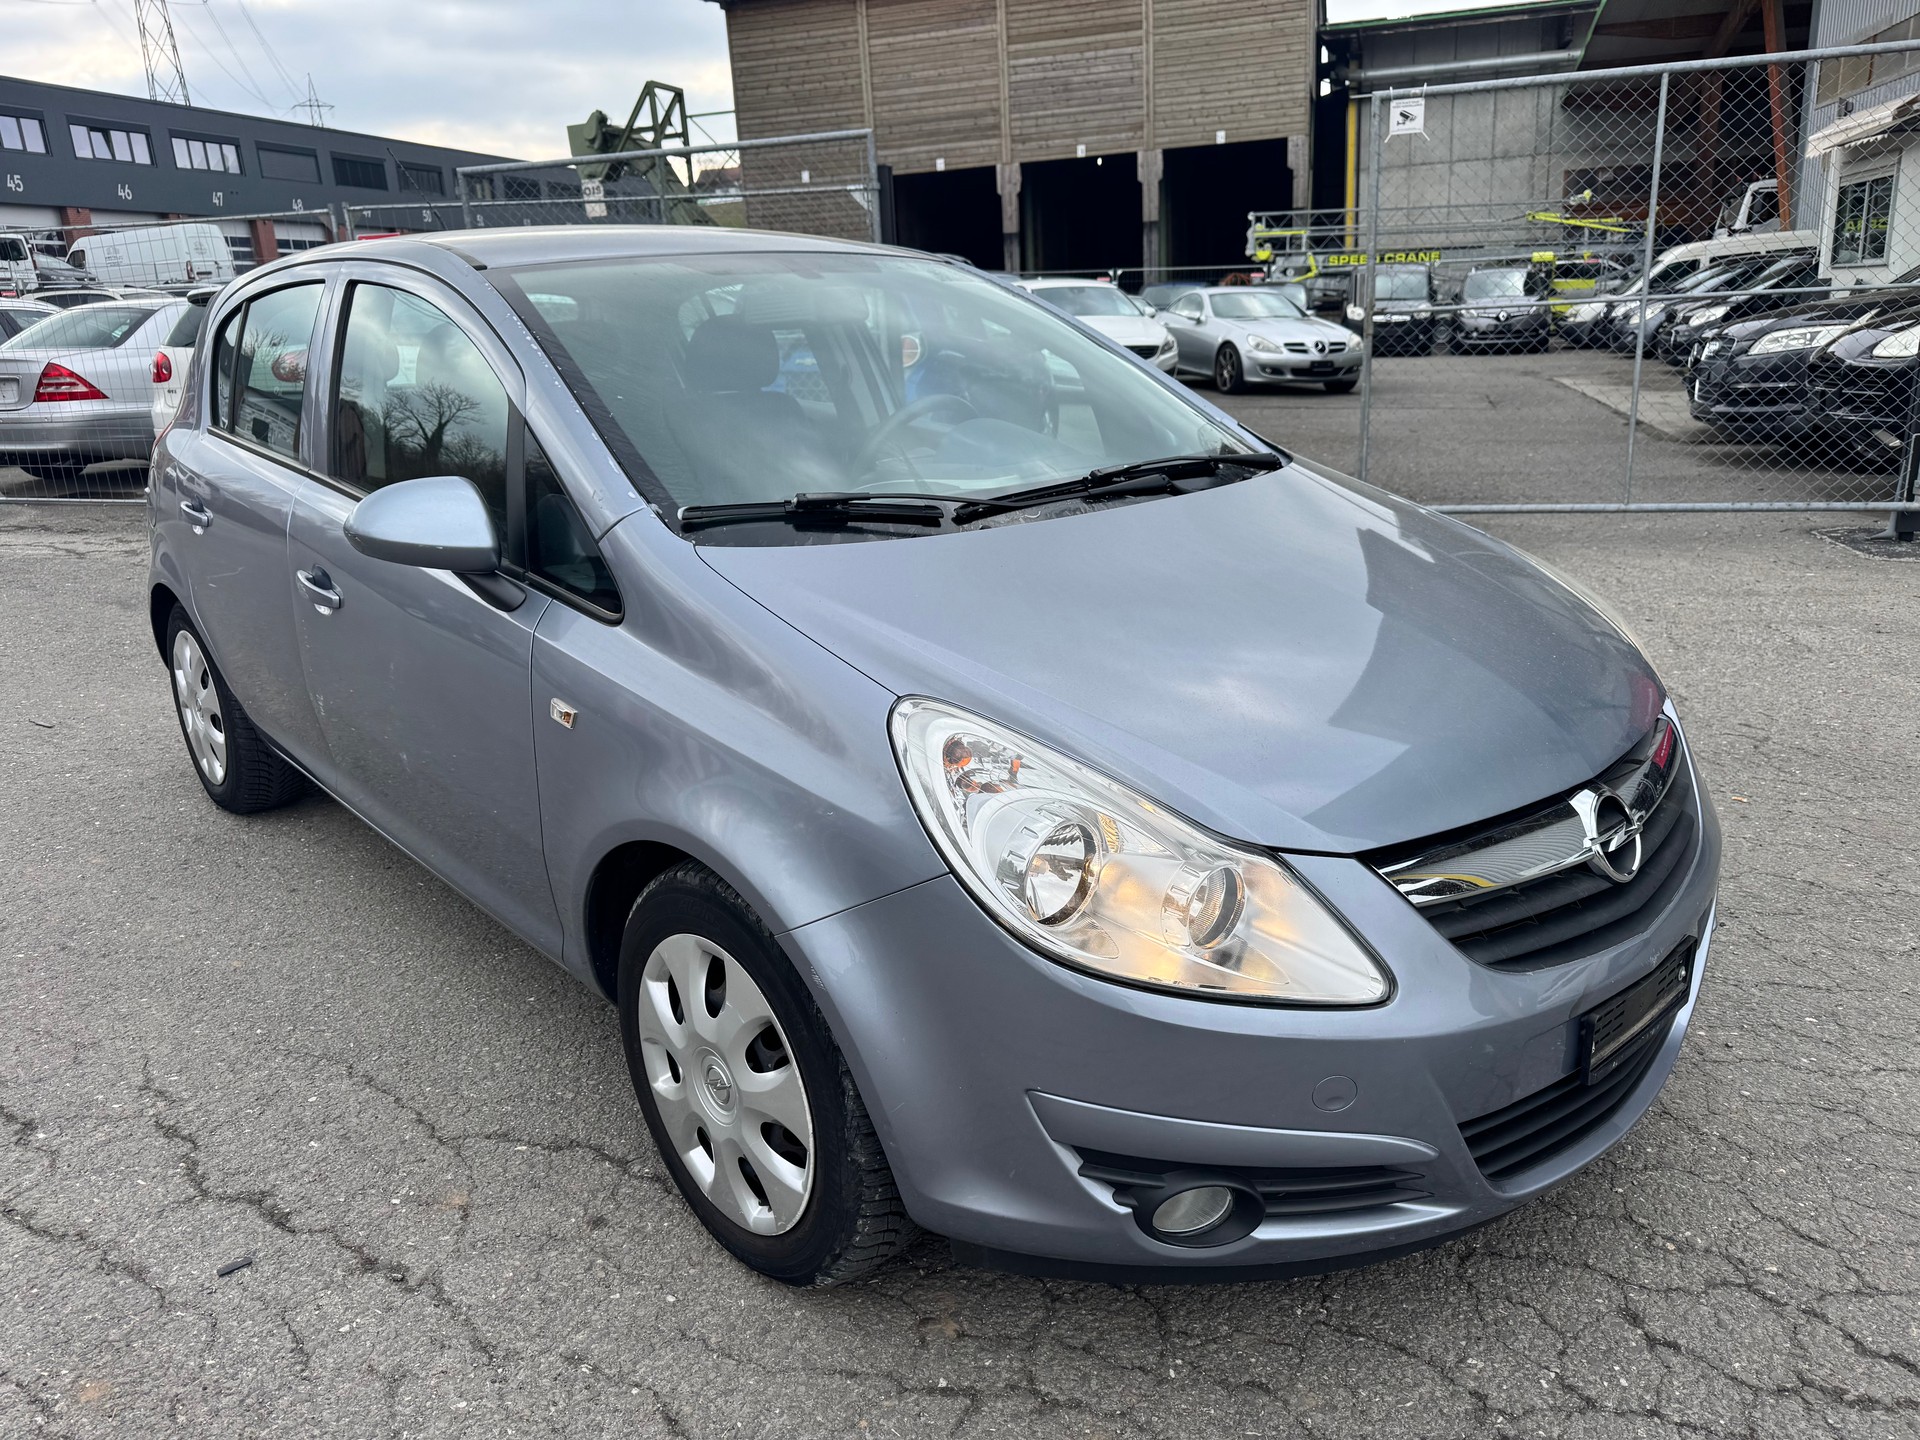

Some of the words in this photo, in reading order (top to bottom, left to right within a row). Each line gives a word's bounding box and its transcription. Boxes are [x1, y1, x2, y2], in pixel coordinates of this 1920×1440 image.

[7, 174, 24, 192] 45
[117, 184, 132, 200] 46
[212, 192, 223, 207] 47
[292, 199, 303, 211] 48
[1384, 250, 1441, 264] CRANE
